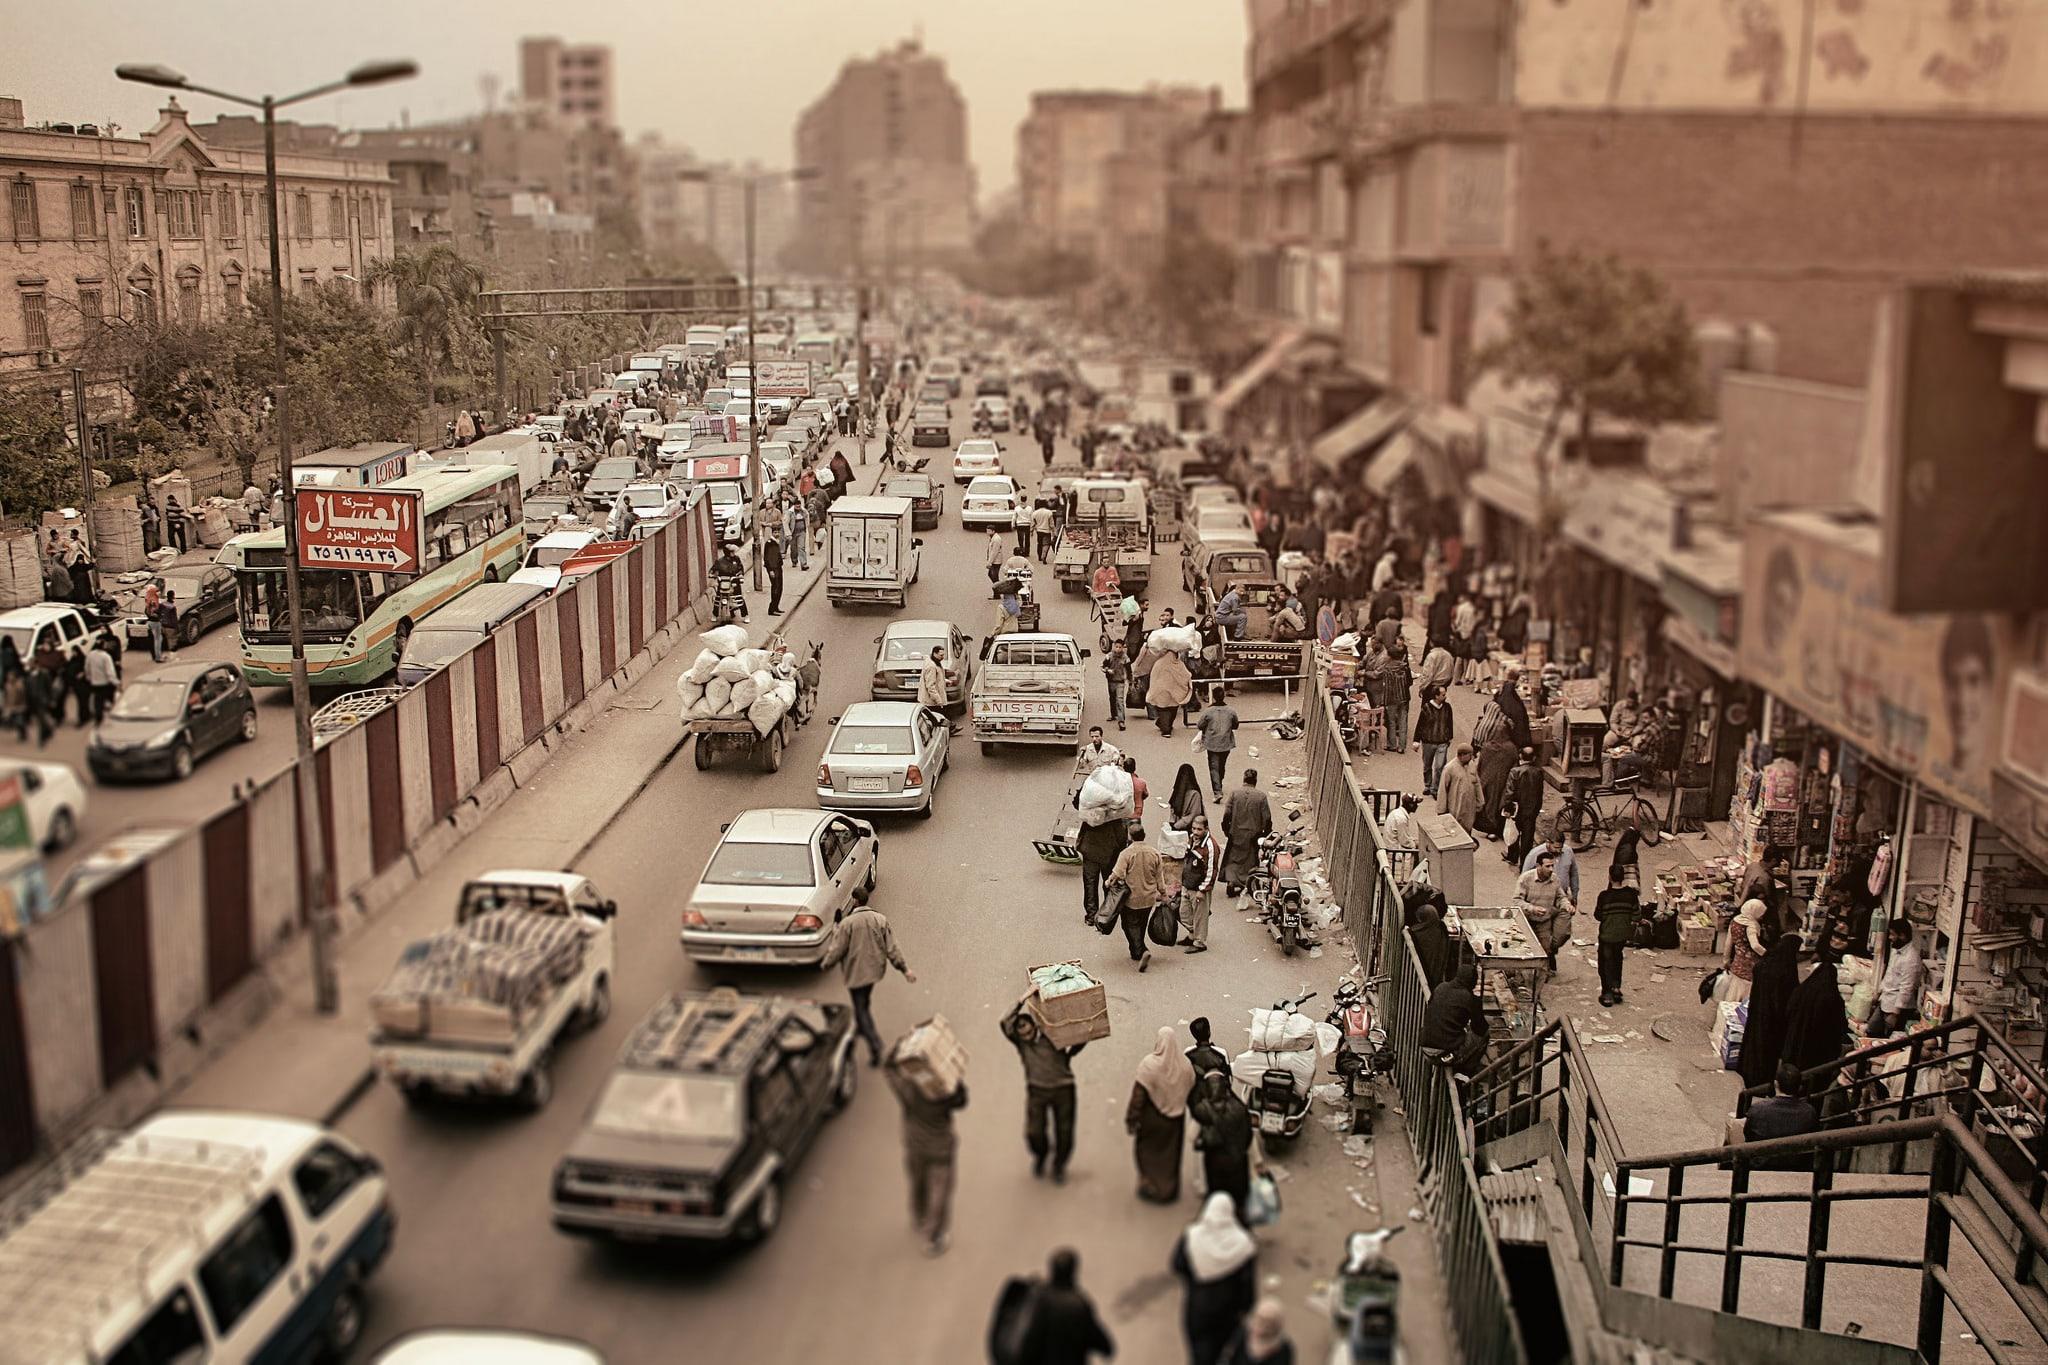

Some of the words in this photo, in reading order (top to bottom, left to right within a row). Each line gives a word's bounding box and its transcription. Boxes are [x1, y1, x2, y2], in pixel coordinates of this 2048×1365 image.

[374, 456, 403, 485] LORD
[341, 495, 374, 508] شركة
[305, 493, 410, 533] العسال
[326, 527, 361, 543] الجاهزة
[361, 531, 397, 545] للملابس
[313, 546, 331, 559] ٢٥
[334, 547, 350, 561] ٩١
[354, 548, 374, 562] ٩٩
[377, 549, 398, 564] ٣٩
[992, 703, 1059, 714] NISSAN
